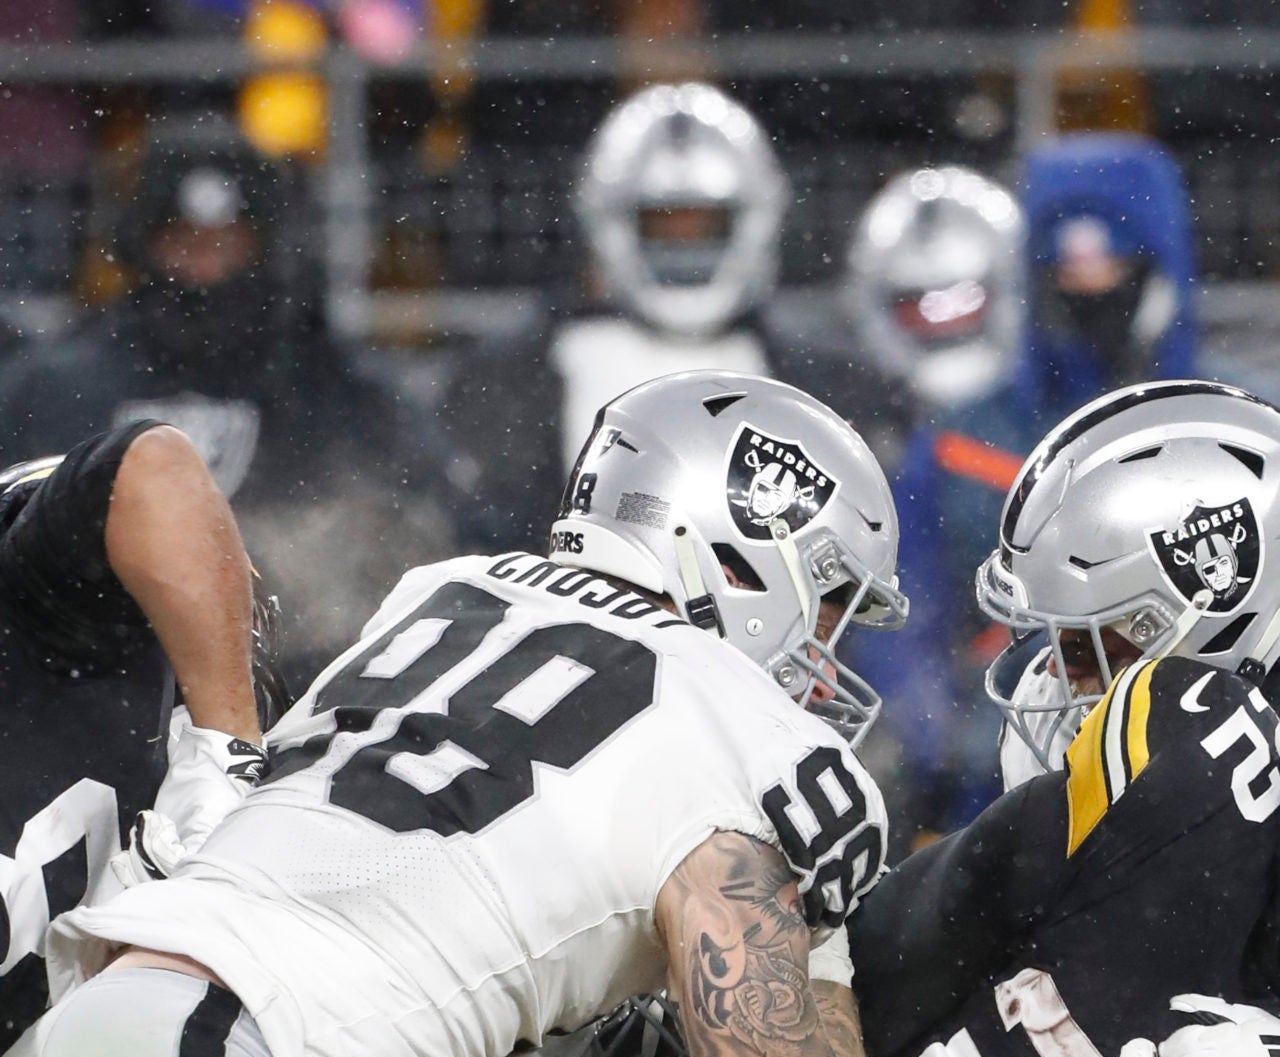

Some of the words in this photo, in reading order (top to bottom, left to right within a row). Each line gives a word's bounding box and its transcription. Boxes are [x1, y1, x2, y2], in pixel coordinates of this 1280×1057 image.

[750, 433, 828, 488] RAIDERS
[1162, 502, 1245, 547] RAIDERS
[259, 580, 660, 838] 98
[761, 745, 882, 929] 98
